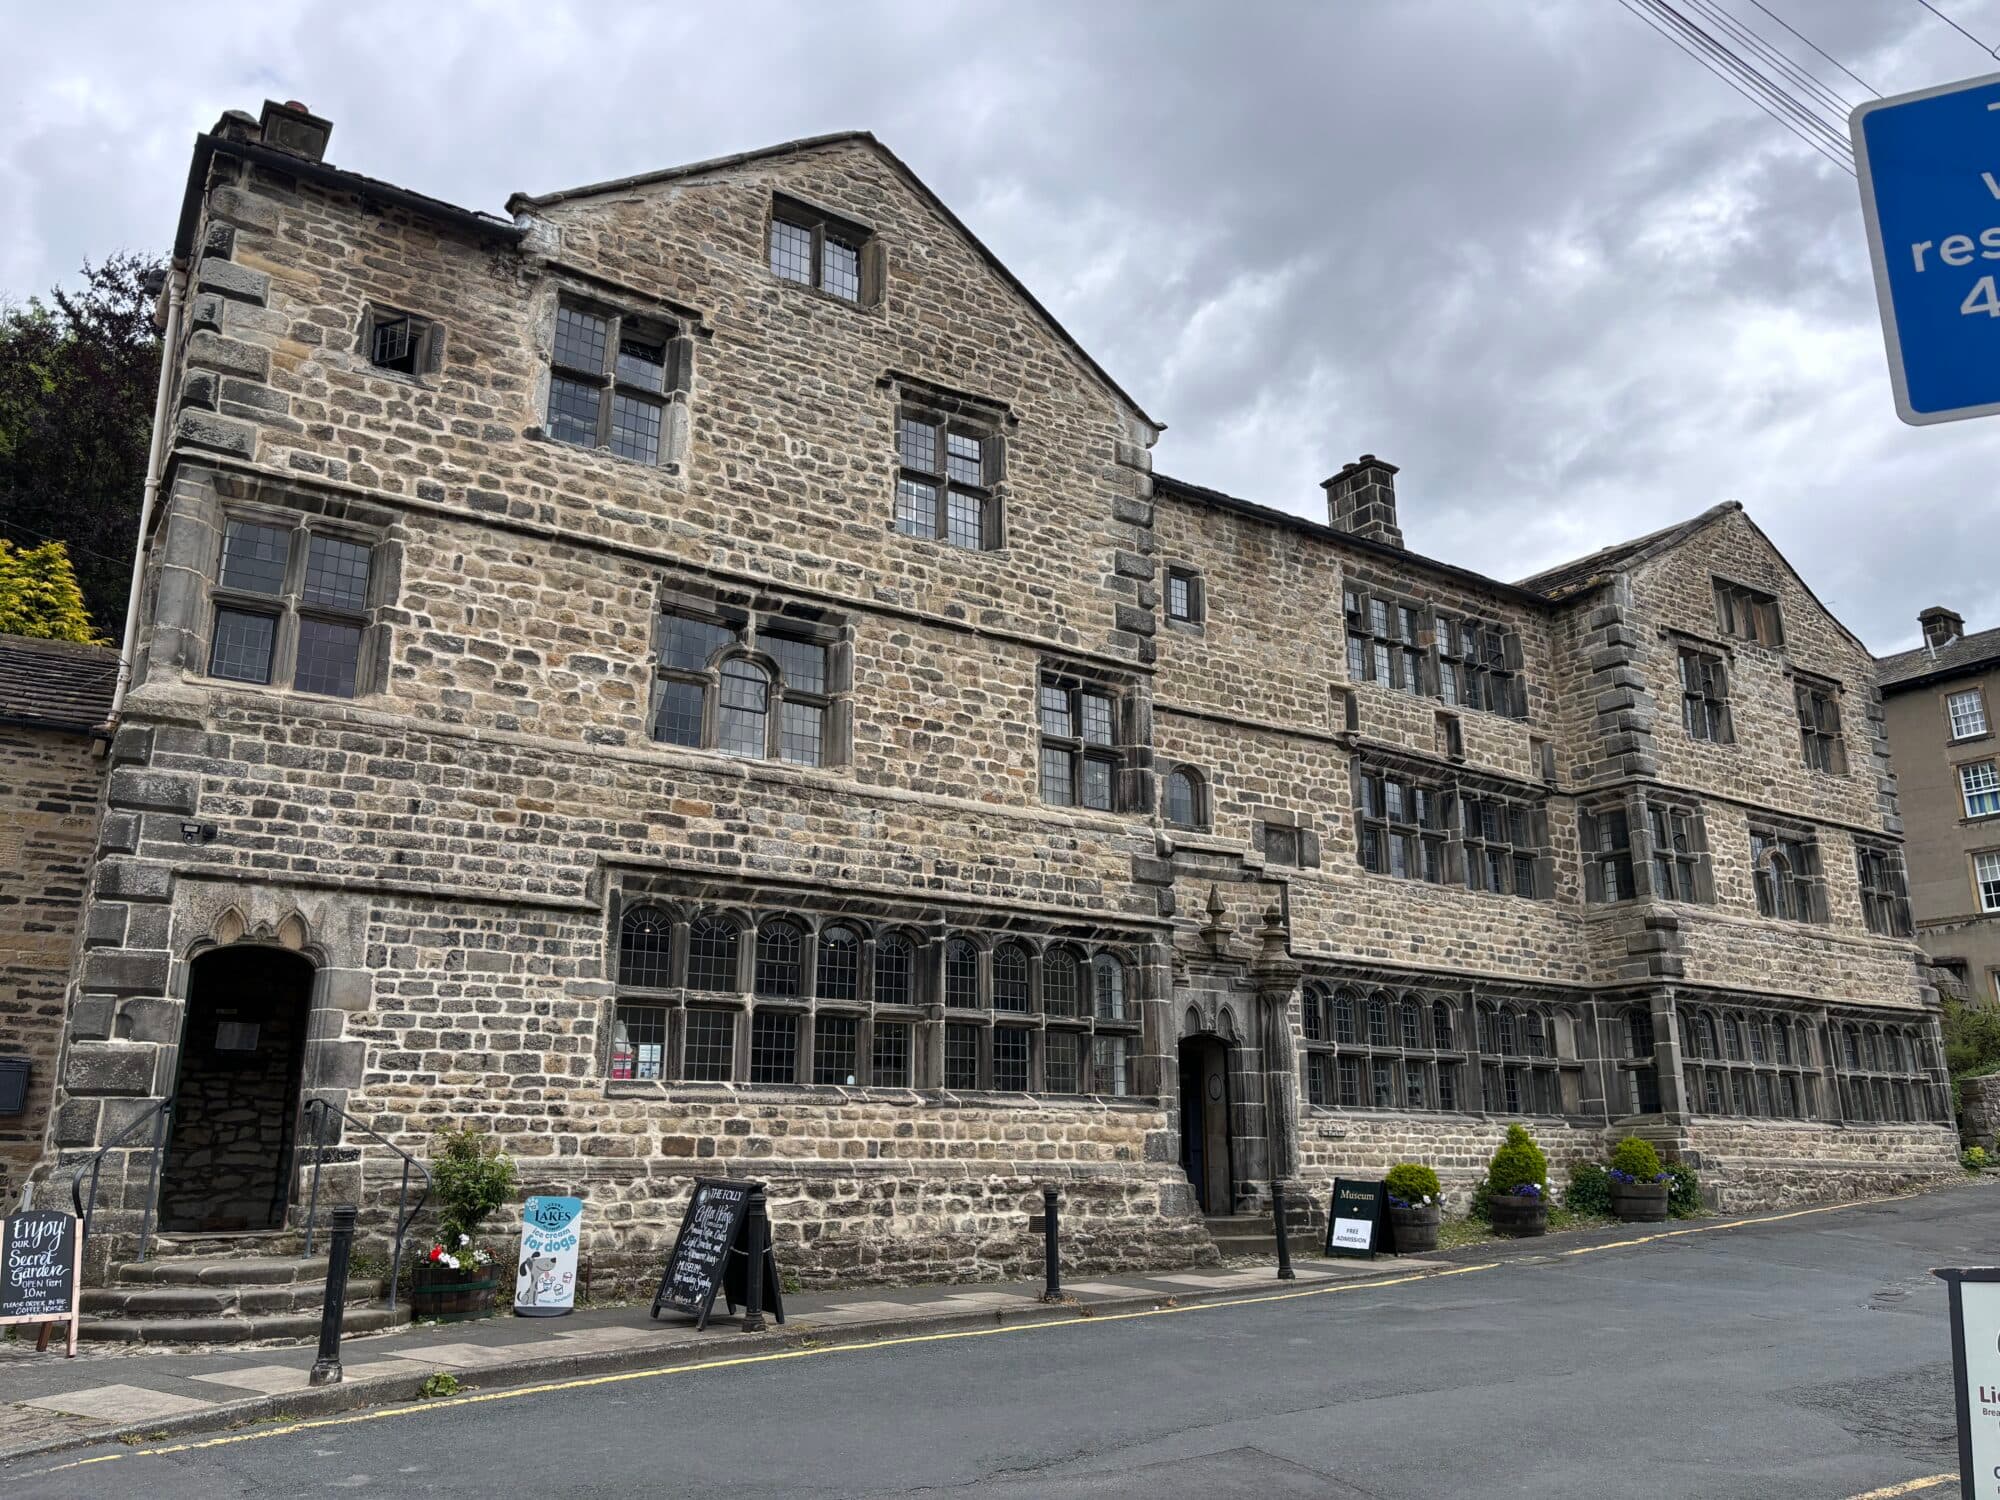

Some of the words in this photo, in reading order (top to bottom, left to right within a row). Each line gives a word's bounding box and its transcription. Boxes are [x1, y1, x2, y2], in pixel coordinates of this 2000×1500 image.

[1911, 227, 2000, 273] res
[1960, 275, 2000, 318] 4
[710, 1188, 723, 1200] THE
[722, 1190, 743, 1201] FOLLY
[1340, 1189, 1375, 1201] Museum
[535, 1210, 571, 1224] LAKES
[13, 1214, 67, 1251] Enjoy!
[532, 1228, 544, 1238] ice
[545, 1229, 571, 1239] cream
[1336, 1235, 1367, 1243] ADMISSION
[11, 1240, 31, 1249] OUR
[524, 1234, 543, 1250] for
[544, 1235, 577, 1252] dogs
[9, 1249, 57, 1267] Secret
[677, 1260, 701, 1274] MUSEUM
[10, 1264, 70, 1287] Garden
[22, 1279, 44, 1288] OPEN
[3, 1301, 24, 1309] PLEASE
[15, 1306, 40, 1315] COFFEE
